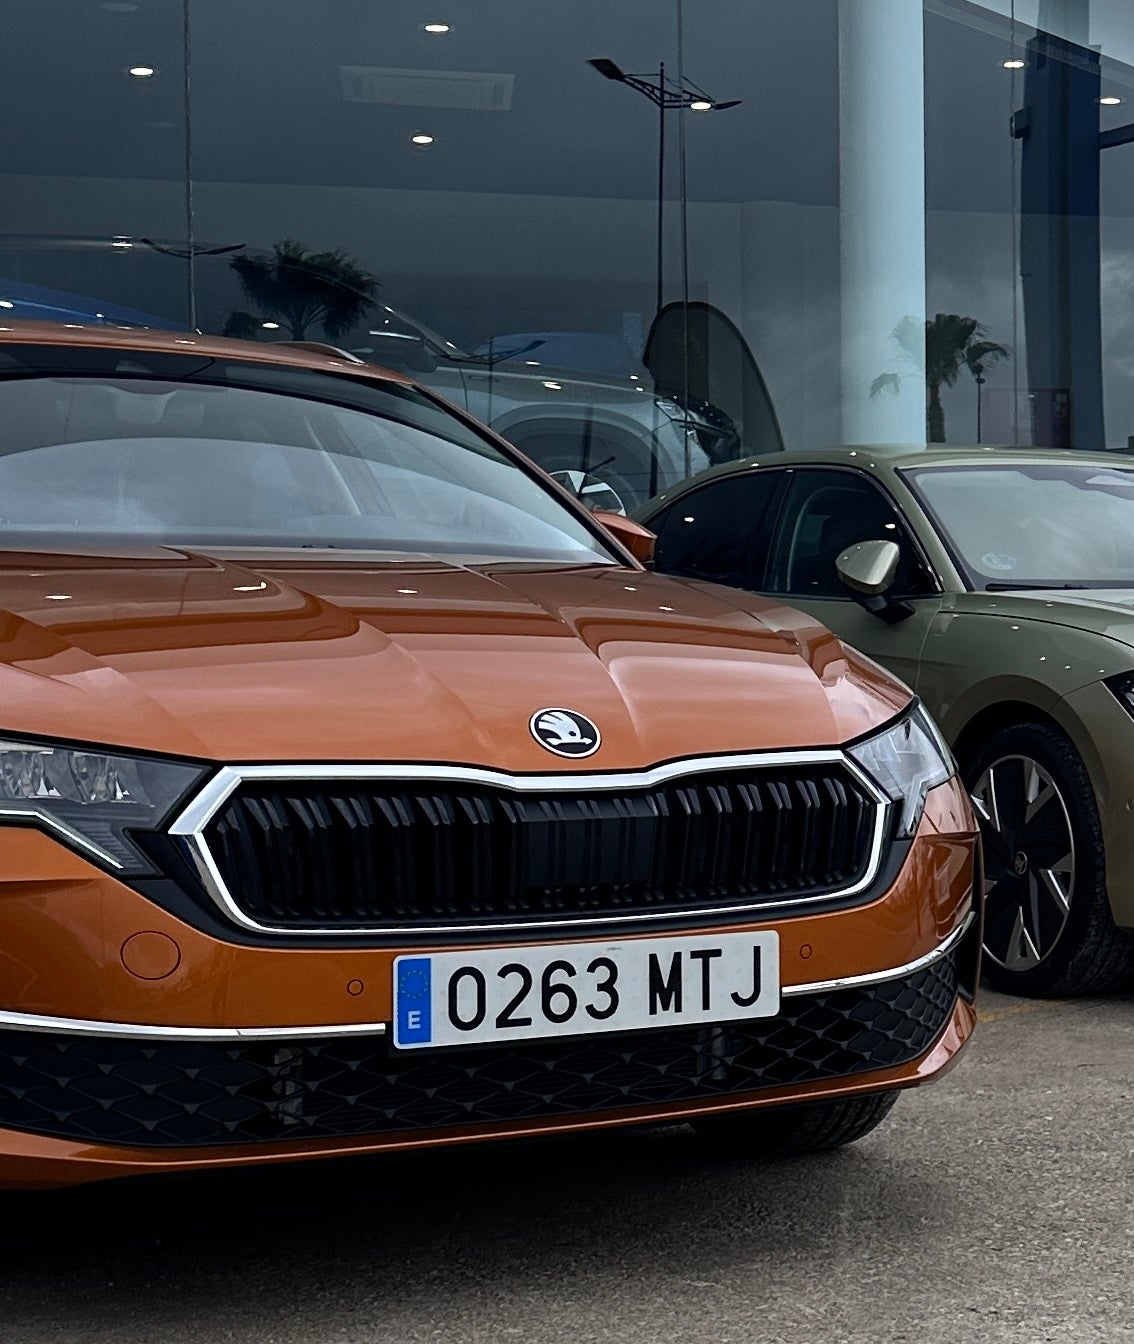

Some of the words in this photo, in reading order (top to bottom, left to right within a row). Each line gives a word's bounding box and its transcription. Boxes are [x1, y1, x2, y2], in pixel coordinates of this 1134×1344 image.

[447, 957, 620, 1032] 0263
[648, 945, 762, 1016] MTJ
[407, 1009, 422, 1031] E
